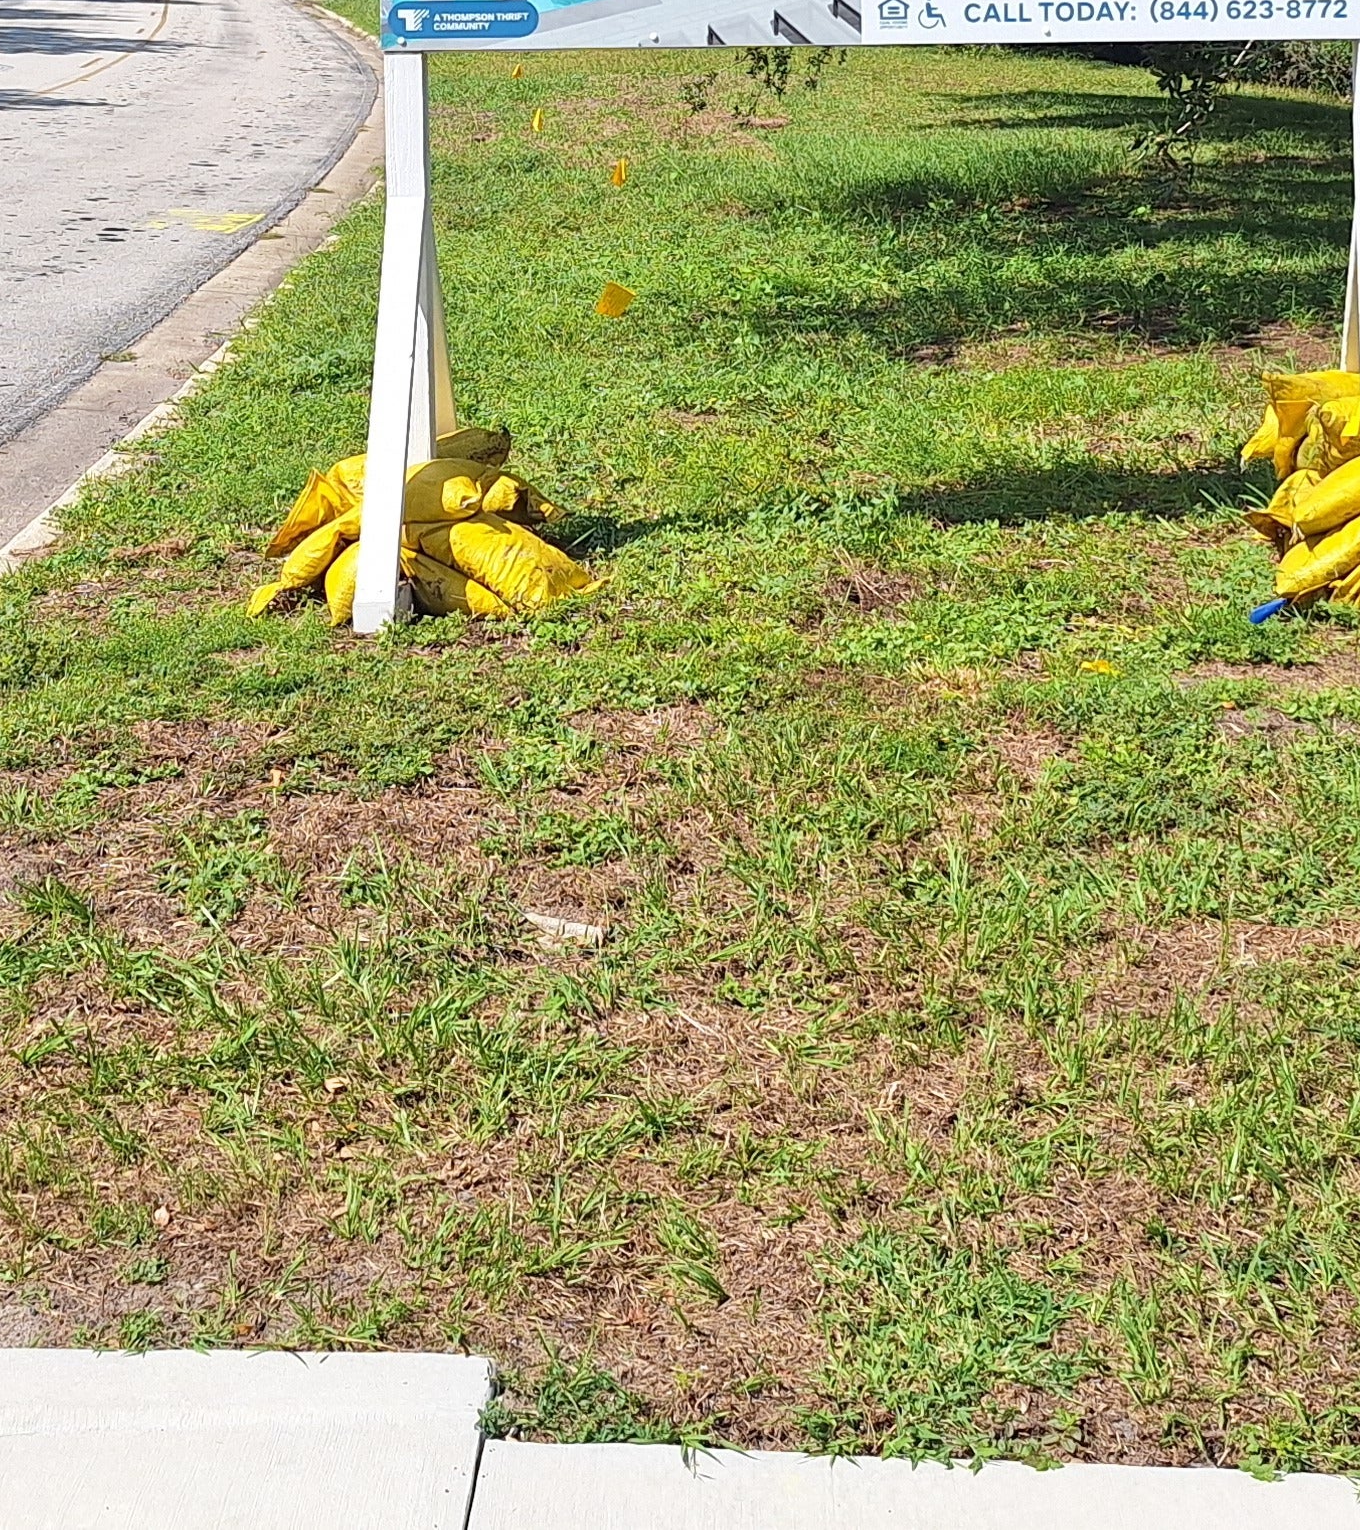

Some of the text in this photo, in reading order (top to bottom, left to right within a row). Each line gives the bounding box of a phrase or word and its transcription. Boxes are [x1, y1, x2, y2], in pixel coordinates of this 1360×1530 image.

[433, 11, 529, 22] A THOMPSON THRIFT
[963, 1, 1032, 24] CALL
[1038, 1, 1137, 23] TODAY:
[433, 22, 490, 31] COMMUNITY
